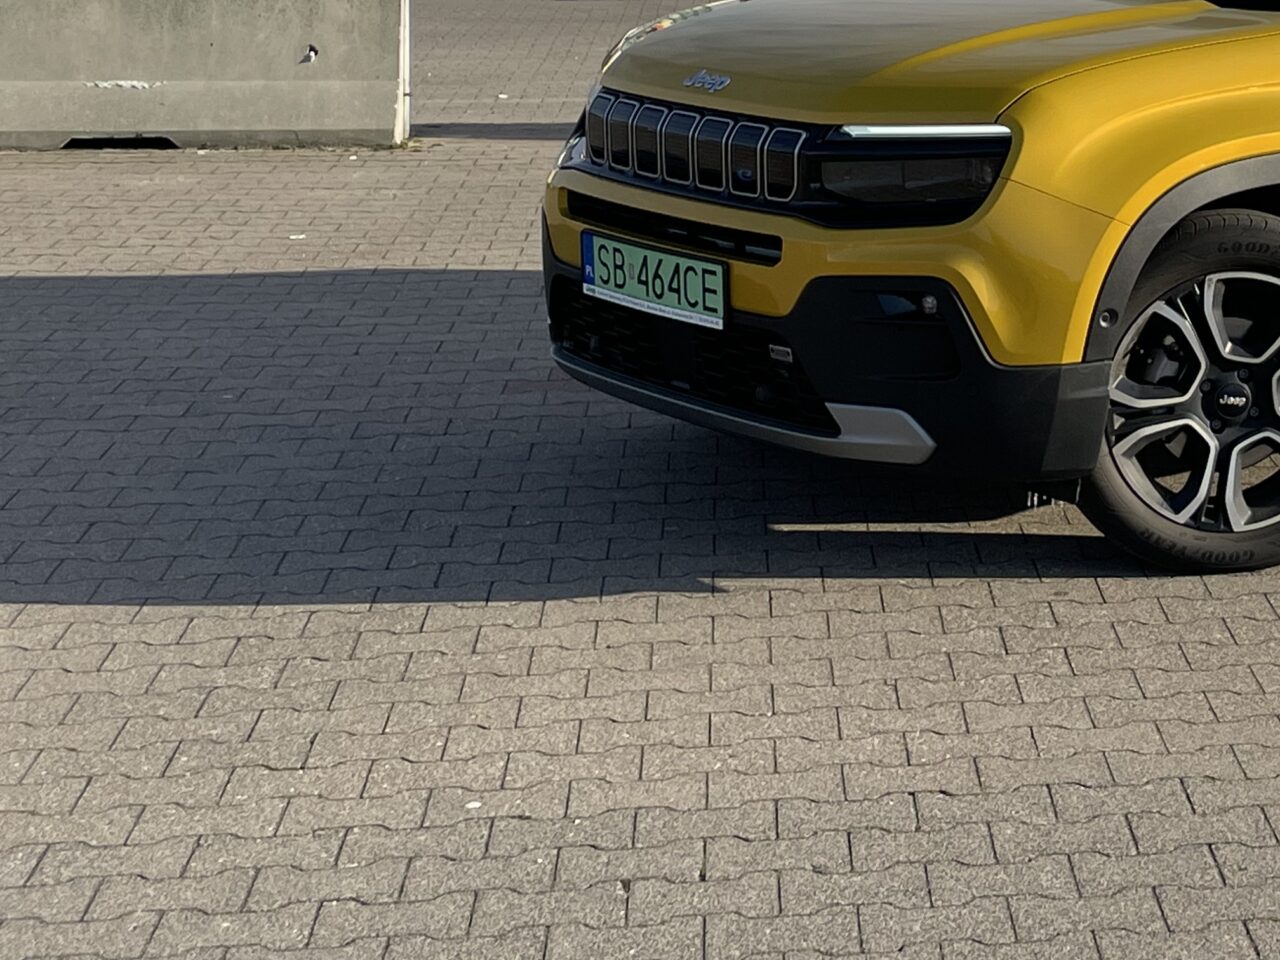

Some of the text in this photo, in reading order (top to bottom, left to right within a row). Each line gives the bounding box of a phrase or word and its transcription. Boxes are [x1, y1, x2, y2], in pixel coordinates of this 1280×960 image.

[683, 69, 731, 93] Jeep
[585, 264, 594, 278] PL
[598, 244, 626, 290] SB
[637, 254, 718, 314] 464CE
[1219, 394, 1246, 407] Jeep
